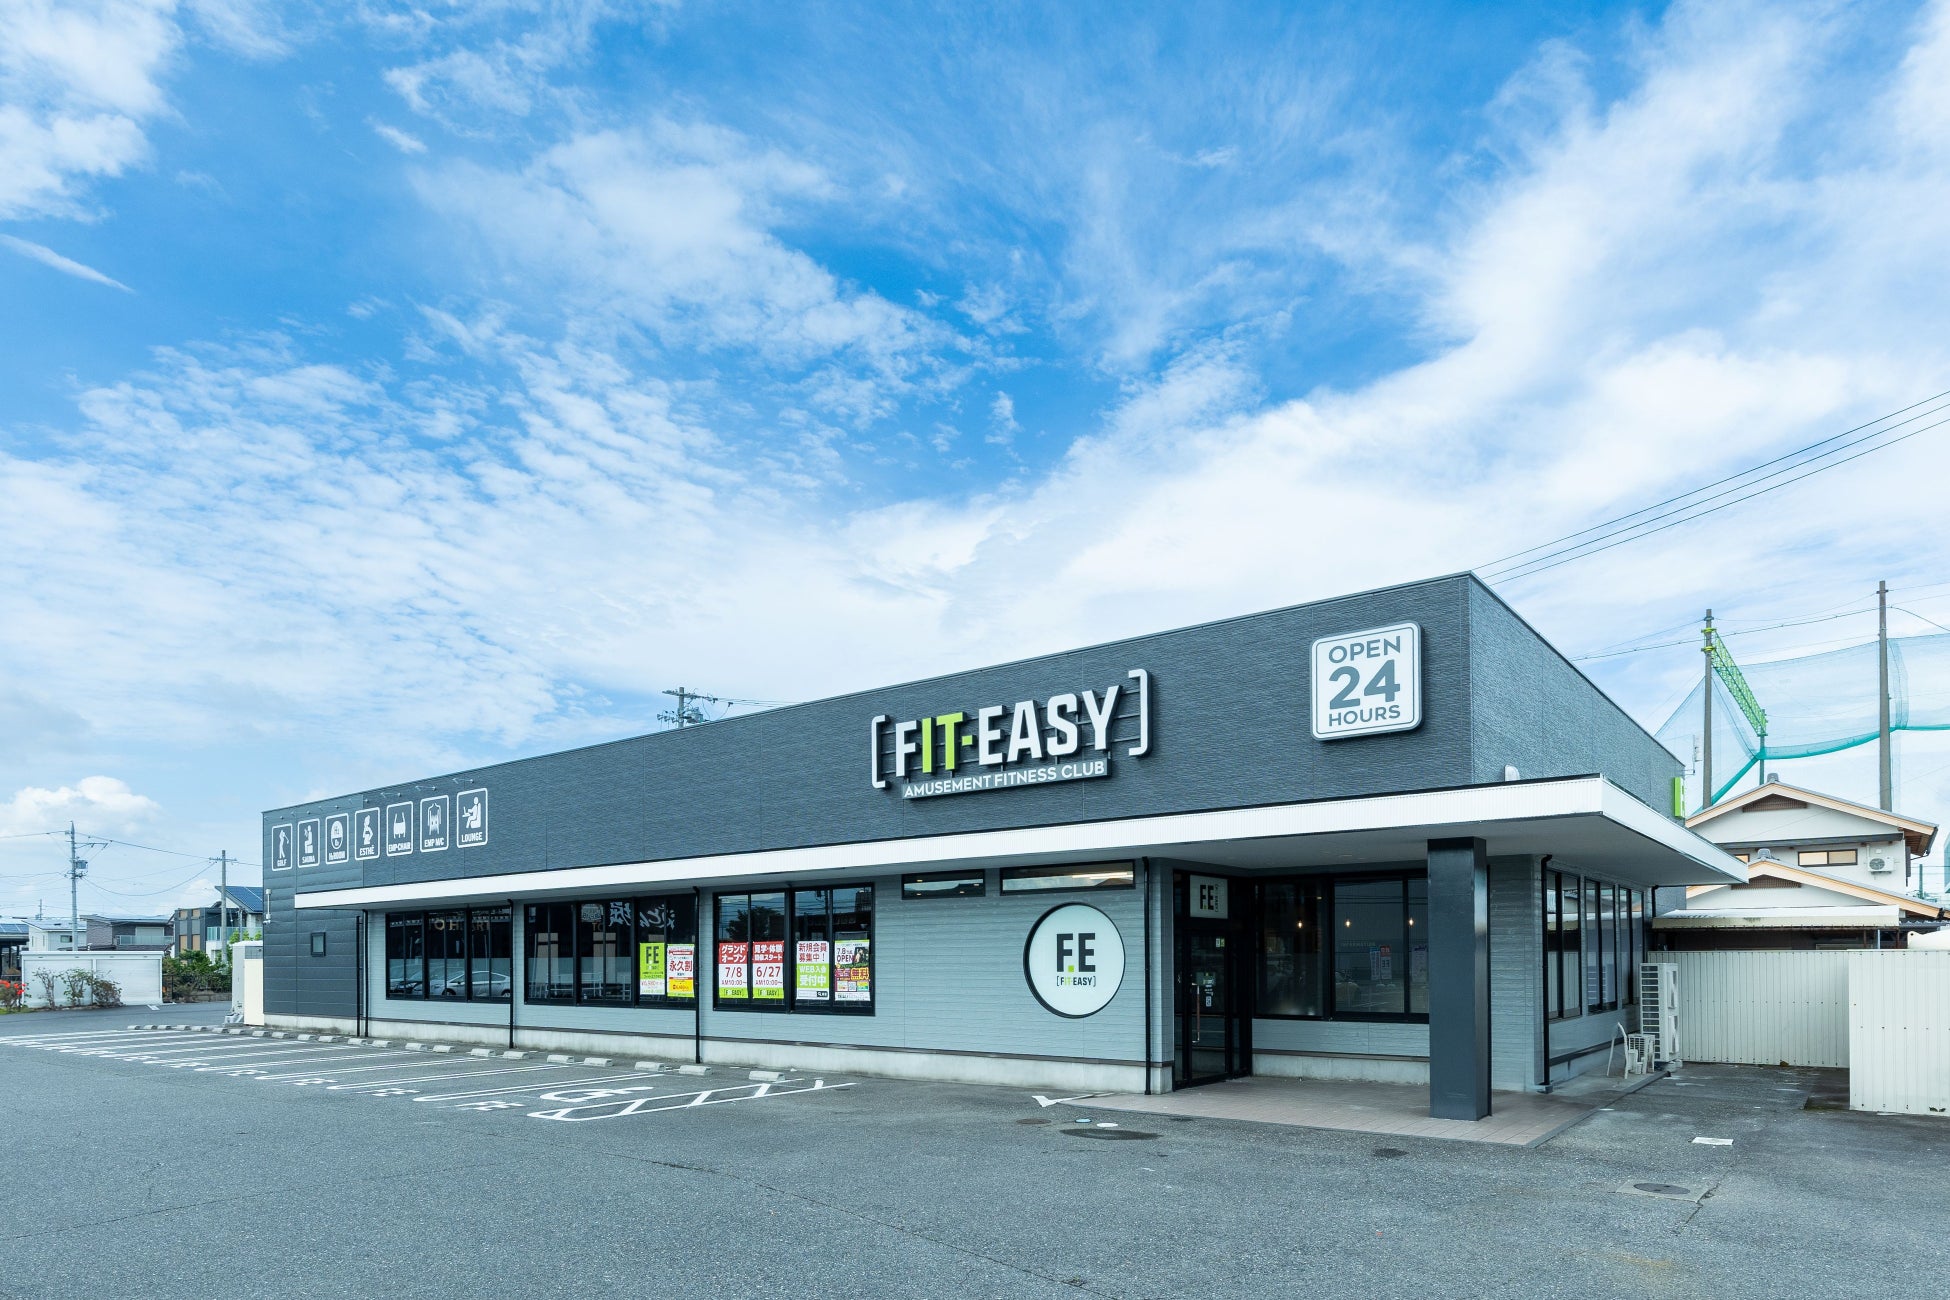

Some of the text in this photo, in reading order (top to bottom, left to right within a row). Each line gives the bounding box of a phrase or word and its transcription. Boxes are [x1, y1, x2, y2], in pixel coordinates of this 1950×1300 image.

[1328, 635, 1401, 664] OPEN
[1329, 659, 1401, 710] 24
[1328, 704, 1401, 727] HOURS
[904, 761, 1105, 798] AMUSEMENT FITNESS CLUB
[461, 832, 483, 842] LOUNGE
[722, 944, 746, 954] グランド
[798, 943, 827, 952] 新規会員
[670, 961, 692, 972] 永久割
[756, 966, 781, 978] 6/27
[725, 967, 742, 978] 7/8
[800, 975, 826, 986] 受付中
